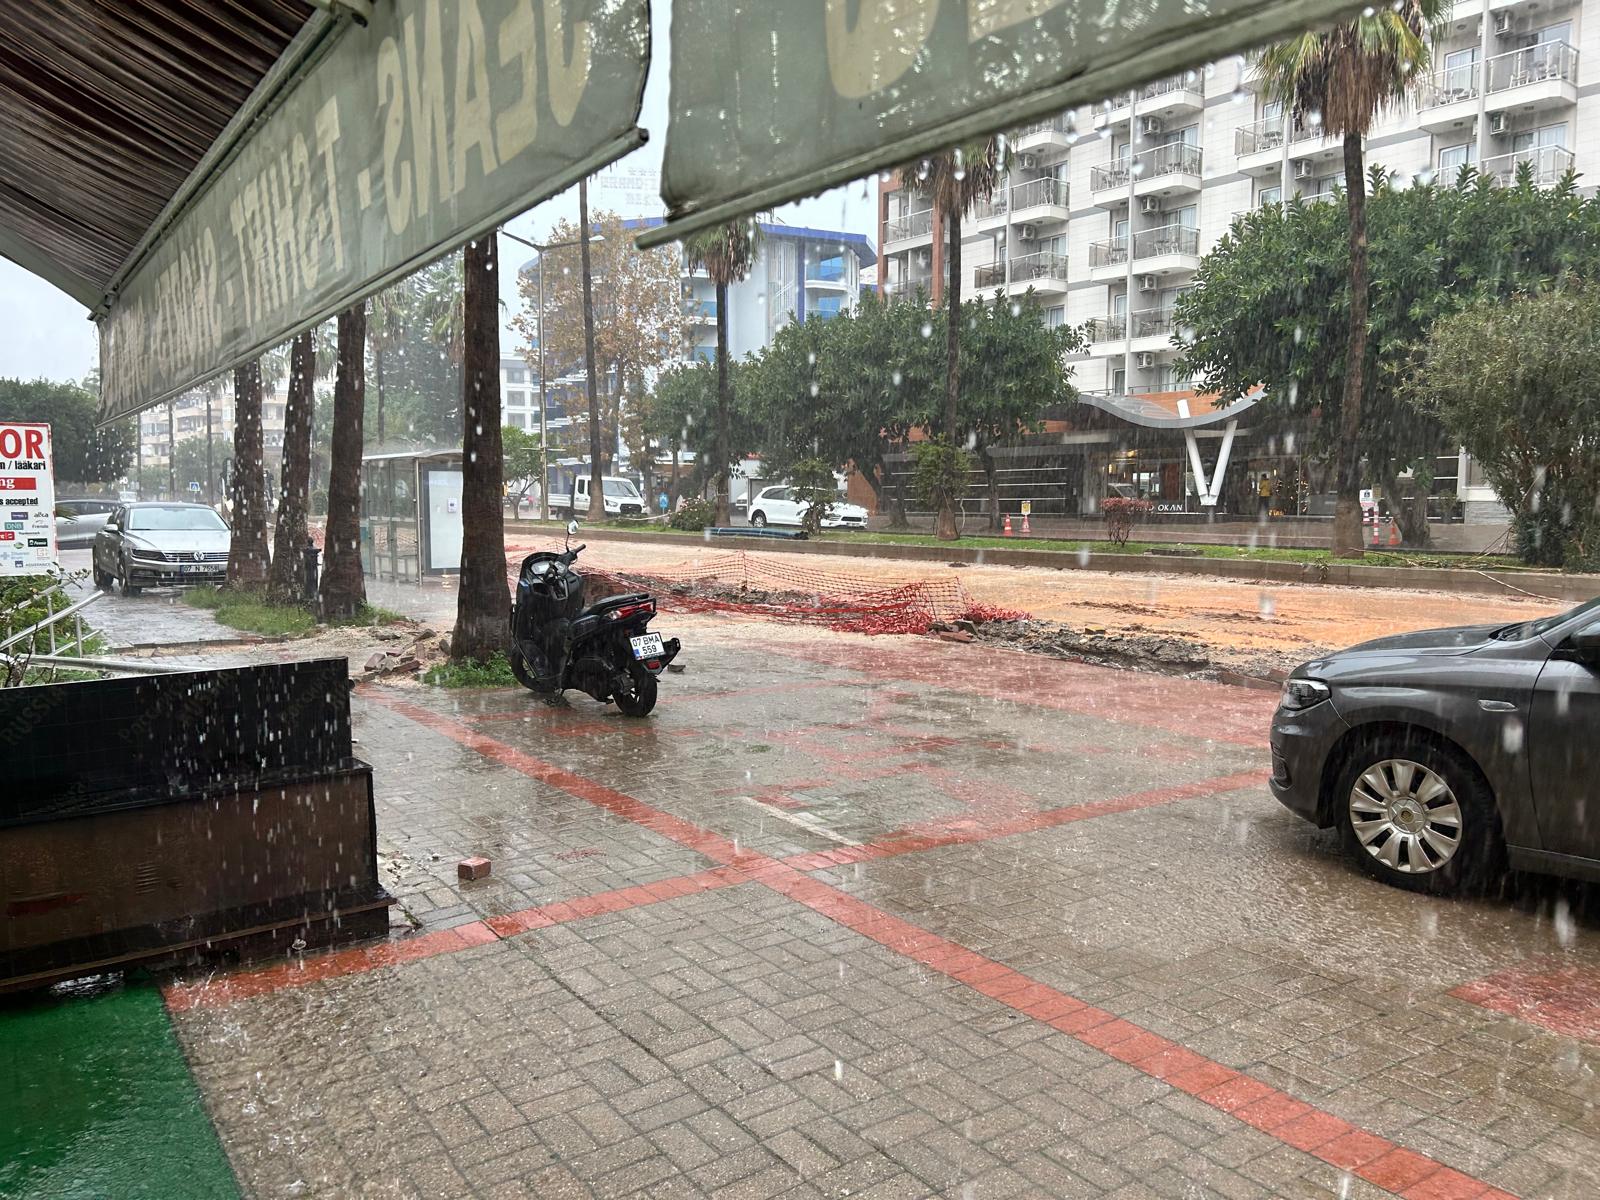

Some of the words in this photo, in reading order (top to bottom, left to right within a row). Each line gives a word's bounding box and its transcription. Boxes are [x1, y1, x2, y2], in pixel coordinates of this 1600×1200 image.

[6, 498, 38, 506] accepted
[1157, 504, 1183, 512] OKAN
[632, 638, 641, 646] 07
[643, 635, 659, 645] BMA
[642, 645, 657, 654] 559
